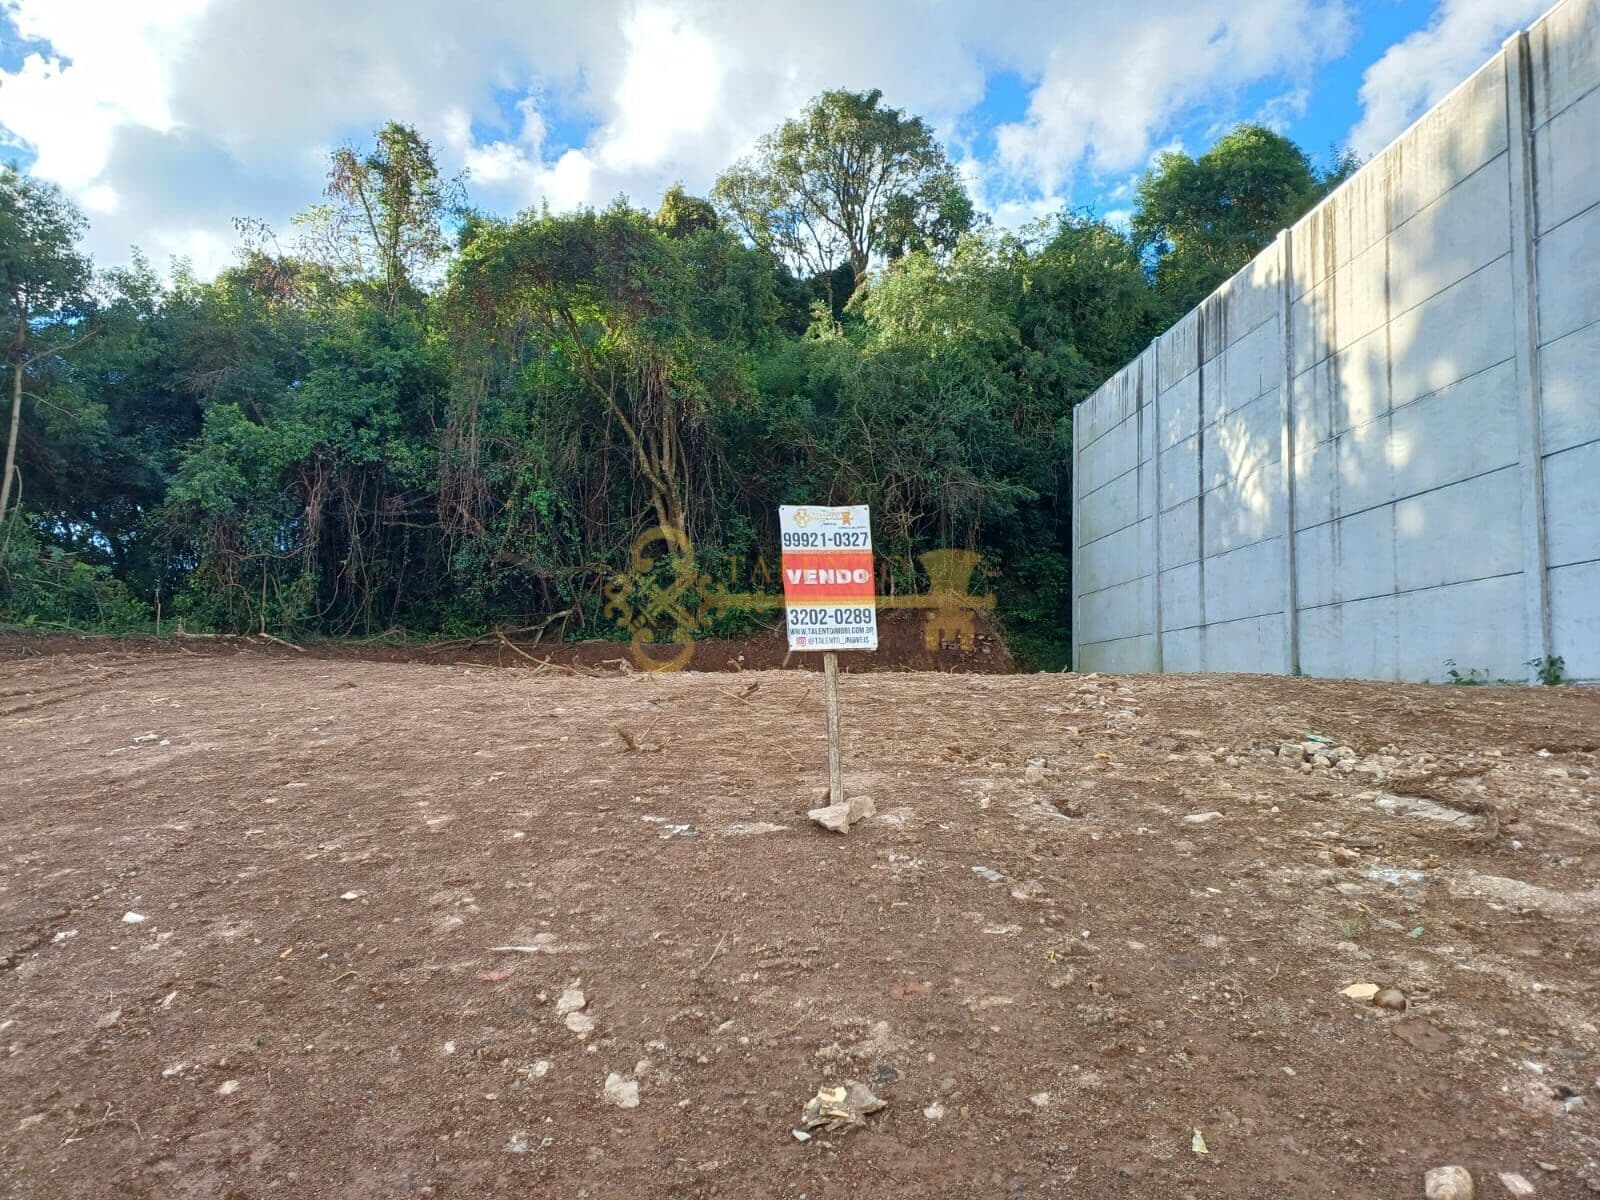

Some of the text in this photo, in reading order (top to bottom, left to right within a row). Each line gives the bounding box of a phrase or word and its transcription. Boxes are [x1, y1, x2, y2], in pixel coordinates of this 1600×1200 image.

[783, 532, 868, 548] 99921-0327
[786, 569, 869, 585] VENDO
[790, 608, 872, 625] 3202-0289
